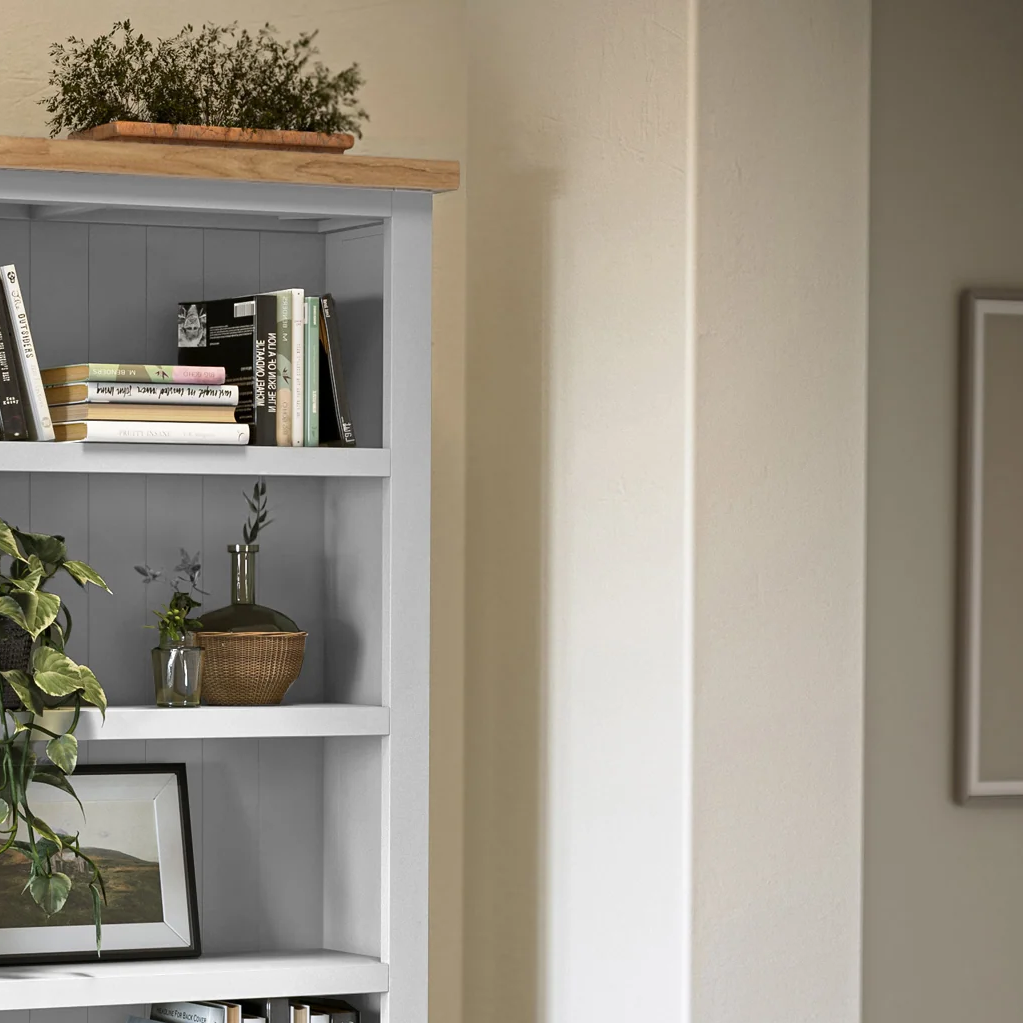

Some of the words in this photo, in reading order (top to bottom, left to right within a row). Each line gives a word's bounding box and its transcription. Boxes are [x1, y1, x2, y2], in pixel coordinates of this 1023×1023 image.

[18, 313, 33, 358] OUTSIDERS
[183, 1012, 193, 1020] BACK
[194, 1015, 206, 1023] COVER
